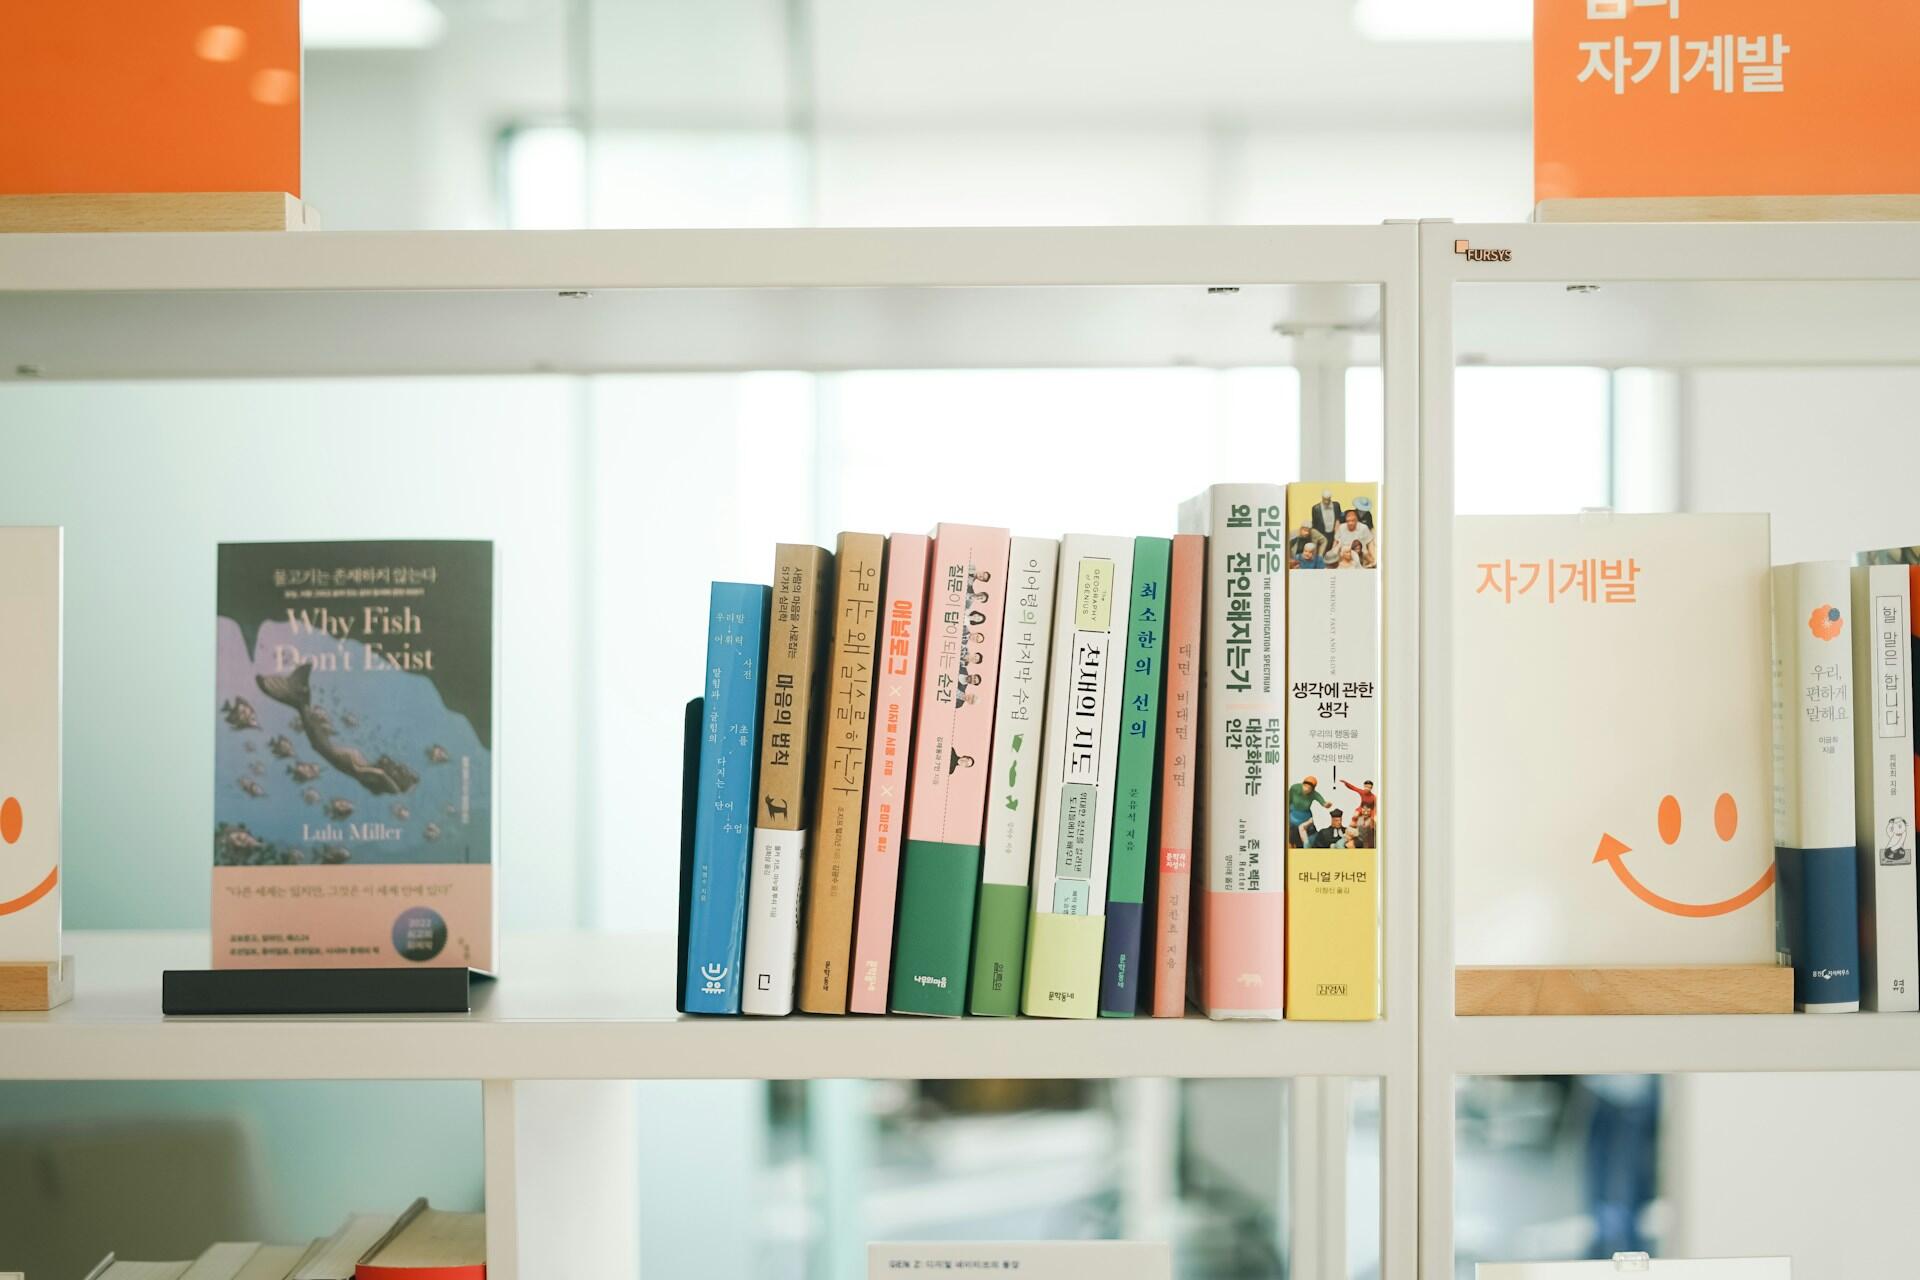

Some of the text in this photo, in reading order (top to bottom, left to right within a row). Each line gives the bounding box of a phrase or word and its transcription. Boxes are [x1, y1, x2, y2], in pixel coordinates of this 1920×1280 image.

[1576, 34, 1790, 95] 자기계발
[1466, 249, 1512, 262] FURSYS
[1257, 504, 1281, 574] 인간은
[778, 566, 790, 622] 51가지 심리학
[846, 561, 876, 624] 우리는
[1091, 569, 1100, 622] GEOGRAPHY
[1475, 558, 1642, 604] 자기계발
[787, 567, 803, 660] 사람의 마음을 사로잡는
[1083, 583, 1091, 615] GENIUS
[1226, 504, 1252, 693] 왜 잔인해지는가
[286, 606, 422, 641] Why Fish
[715, 612, 745, 624] 우리말
[936, 564, 964, 703] 질문이 답이 되는 순간
[1329, 575, 1337, 675] THINKING, FAST AND SLOW
[714, 634, 743, 647] 어휘력
[843, 629, 871, 654] 왜
[888, 600, 913, 676] 애널로그
[1011, 559, 1041, 722] 이어령의 마지막 수업
[1263, 577, 1271, 693] THE OBJECTIFICATION SPECTRUM
[274, 641, 434, 672] Don't Exist
[743, 658, 753, 680] 사전
[1130, 581, 1158, 739] 최소한의 선의
[1810, 664, 1842, 681] 우리,
[1883, 606, 1900, 726] 할 말은 합니다
[1292, 681, 1375, 699] 생각에 관한
[1806, 685, 1848, 701] 편하게
[770, 673, 794, 766] 마음의 법칙
[1071, 643, 1101, 774] 천재의 지도
[1173, 644, 1192, 787] 대면 비대면 외면
[1317, 702, 1349, 718] 생각
[1806, 706, 1849, 722] 말해요
[1226, 718, 1243, 750] 인간
[1265, 718, 1280, 765] 타인을
[1309, 729, 1359, 739] 우리의 행동을
[1316, 741, 1349, 751] 지배하는
[715, 756, 727, 789] 다지는
[832, 731, 863, 795] 하는가
[1245, 718, 1263, 797] 대상화하는
[1312, 753, 1354, 763] 생각의 반란
[714, 801, 734, 811] 단어
[303, 823, 403, 841] Lulu Miller
[723, 823, 743, 834] 수업
[1126, 829, 1136, 851] 지음
[1239, 818, 1247, 840] John
[1239, 861, 1247, 890] Rector
[1248, 839, 1260, 891] 존 M. 렉터
[1298, 871, 1367, 883] 대니얼 카너먼
[1049, 991, 1075, 1002] 문학동네
[1318, 985, 1347, 995] 김영사
